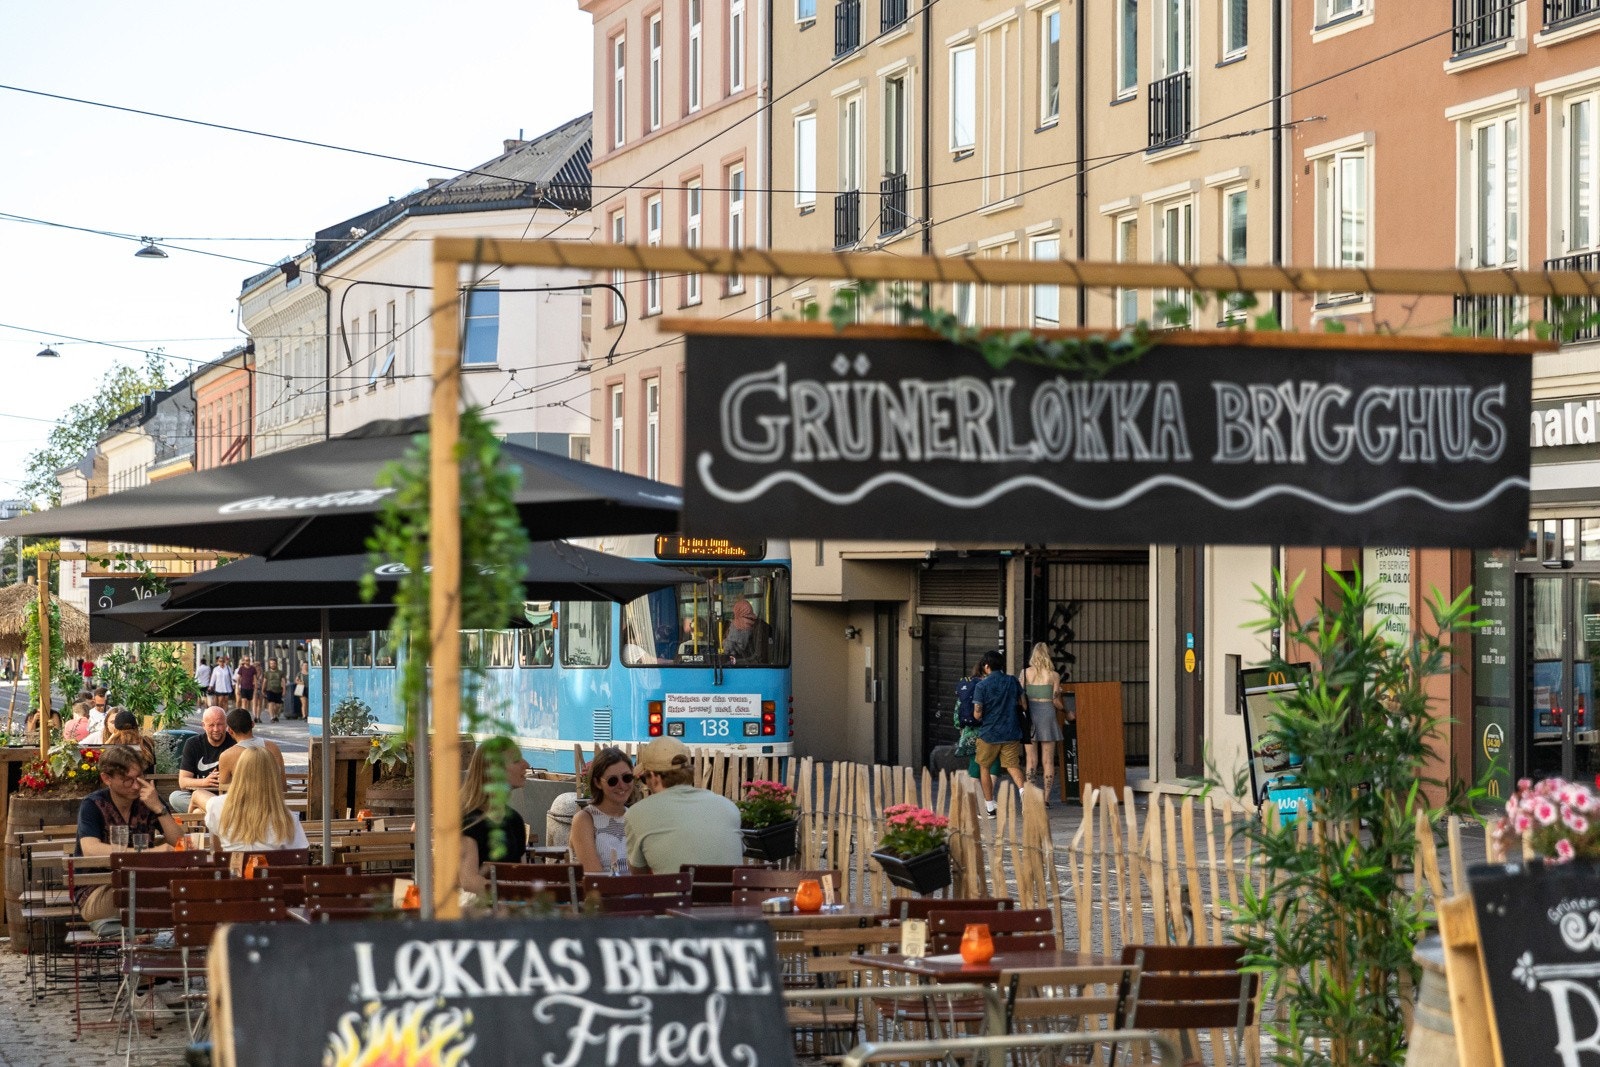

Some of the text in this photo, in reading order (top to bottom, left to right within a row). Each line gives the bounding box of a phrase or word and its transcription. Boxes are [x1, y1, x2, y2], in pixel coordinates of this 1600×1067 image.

[719, 352, 1508, 467] GRÜNERLØKKA BRYGGHUS
[1379, 573, 1392, 584] FRA
[700, 719, 730, 737] 138
[351, 937, 771, 1000] LØKKAS BESTE
[533, 993, 756, 1067] Fried
